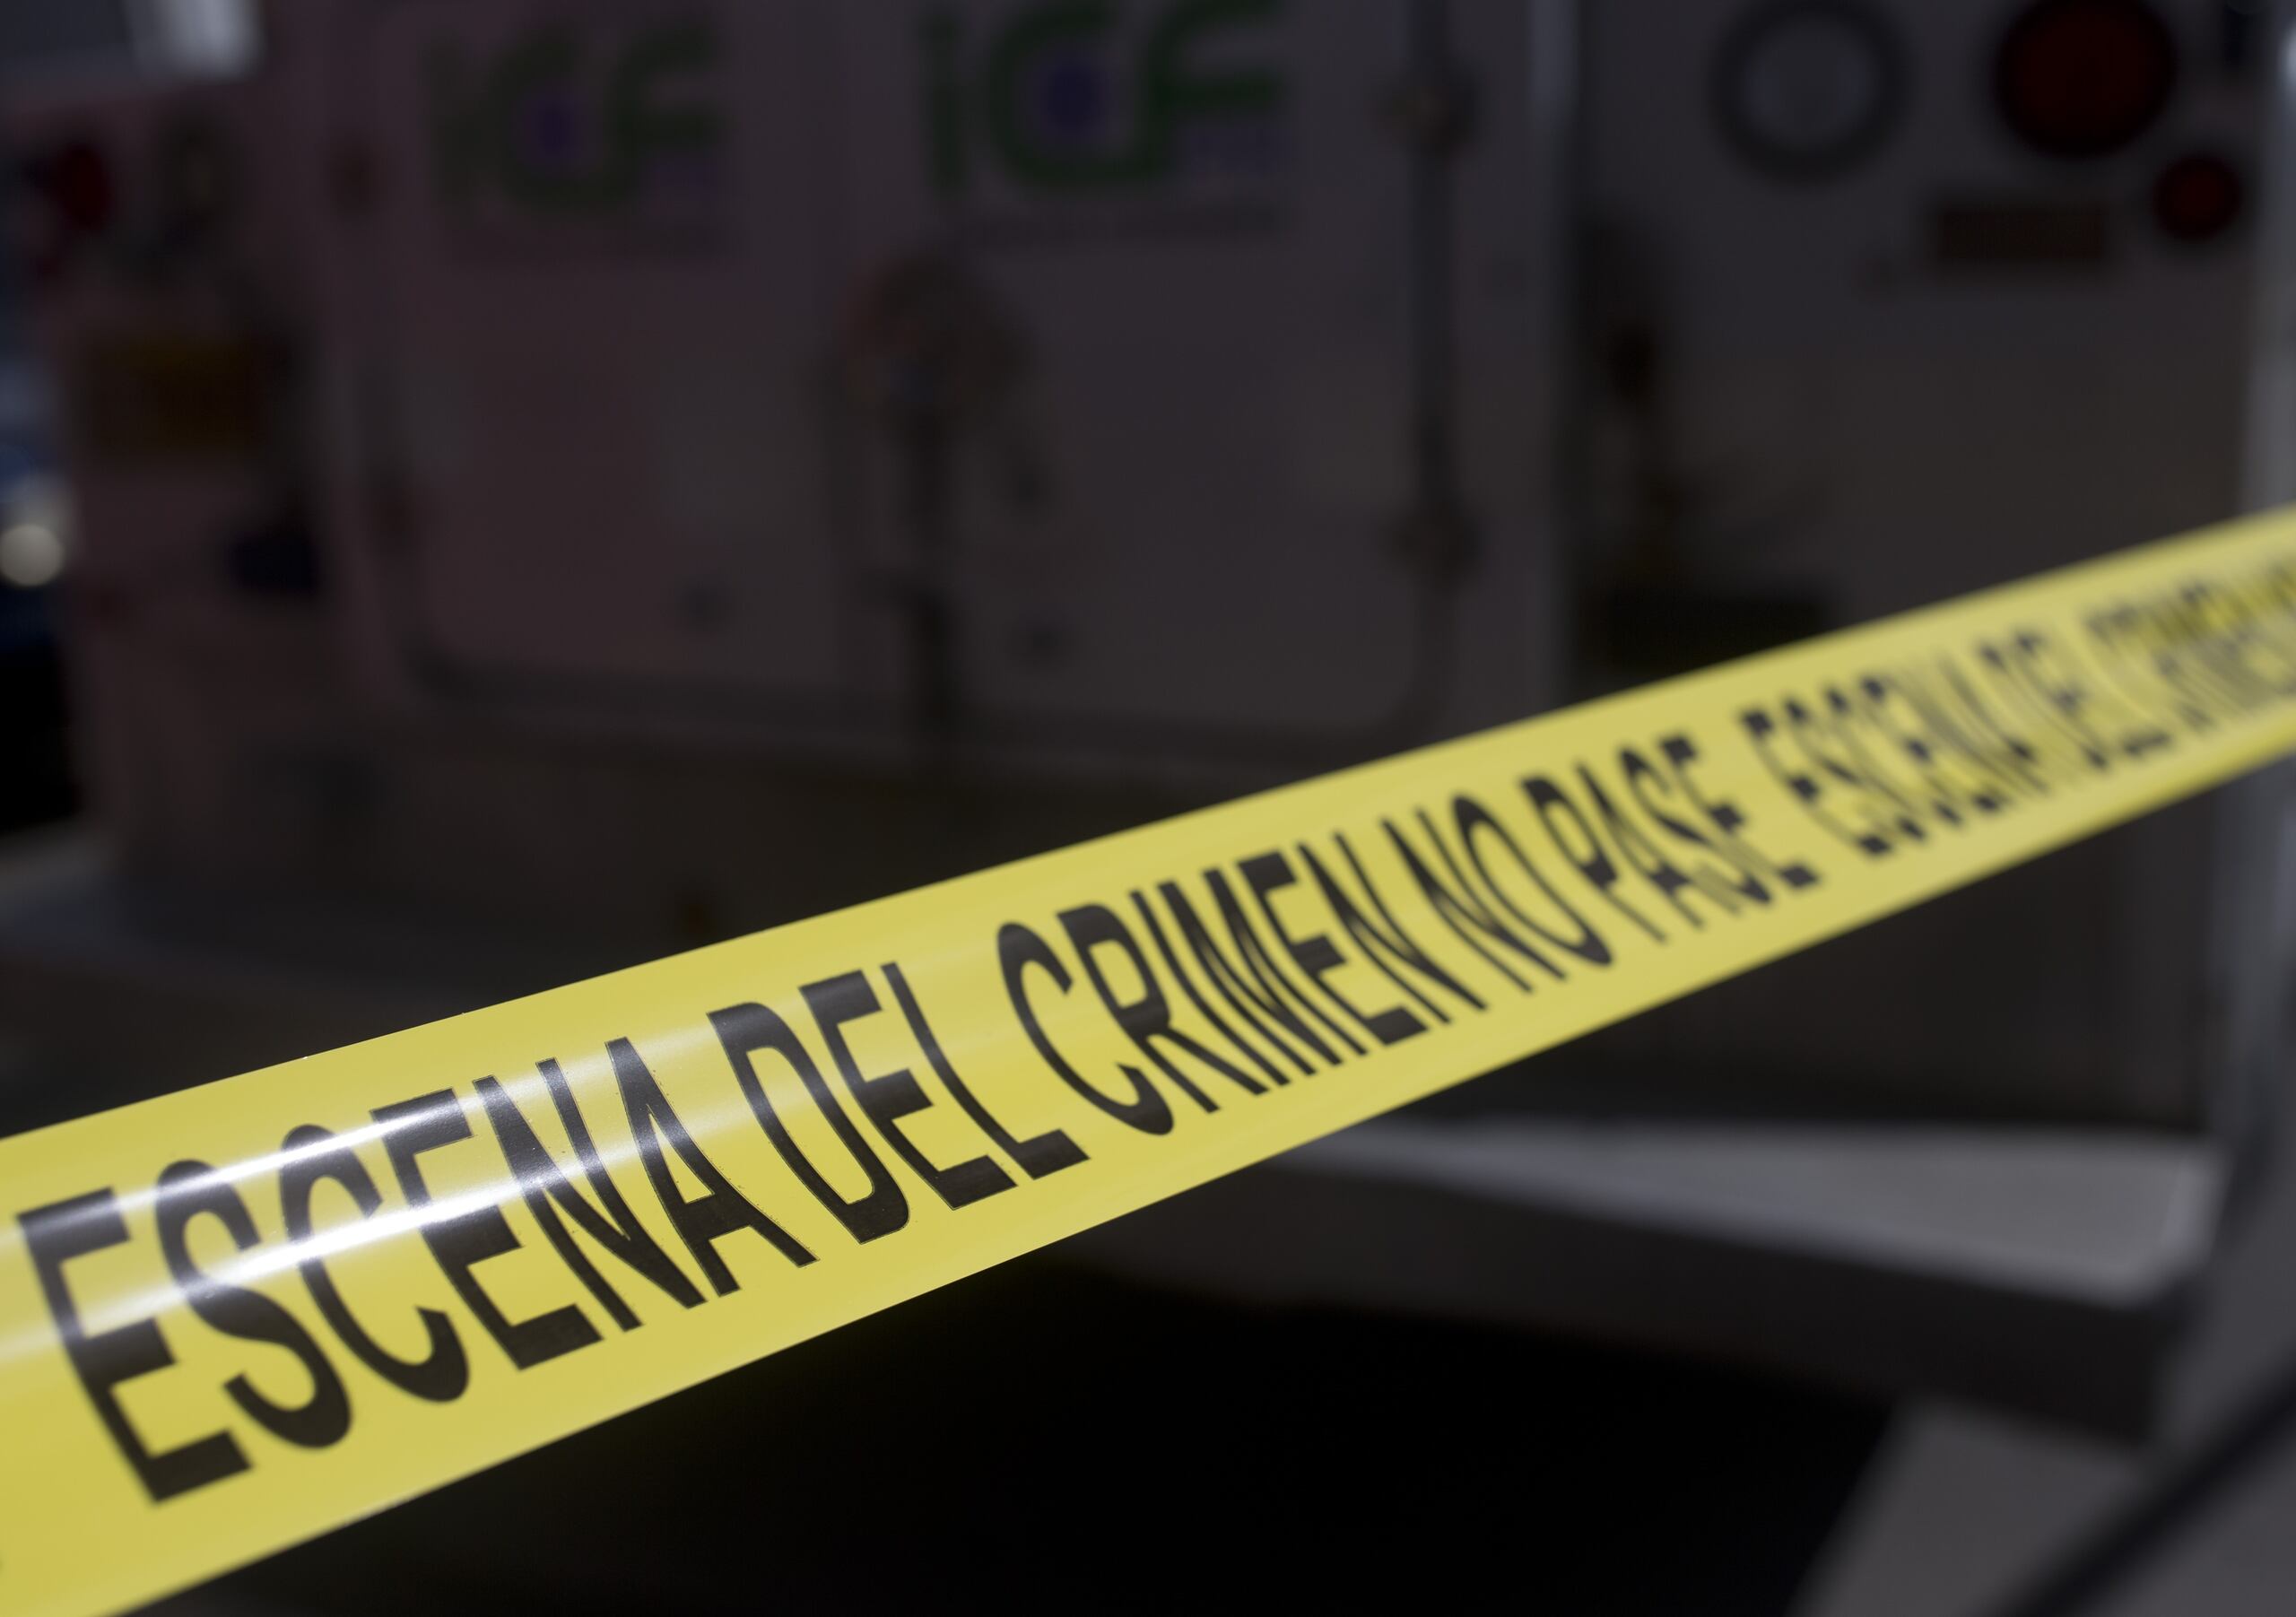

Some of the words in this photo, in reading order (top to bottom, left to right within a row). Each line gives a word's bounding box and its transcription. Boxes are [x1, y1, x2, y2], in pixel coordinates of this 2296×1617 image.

[16, 1037, 820, 1505] ESCENA
[706, 961, 1091, 1244] DEL
[996, 831, 1490, 1136] CRIMEN
[1379, 795, 1613, 994] NO
[1518, 733, 1822, 945] PASE
[1740, 653, 2052, 857] ESCENA
